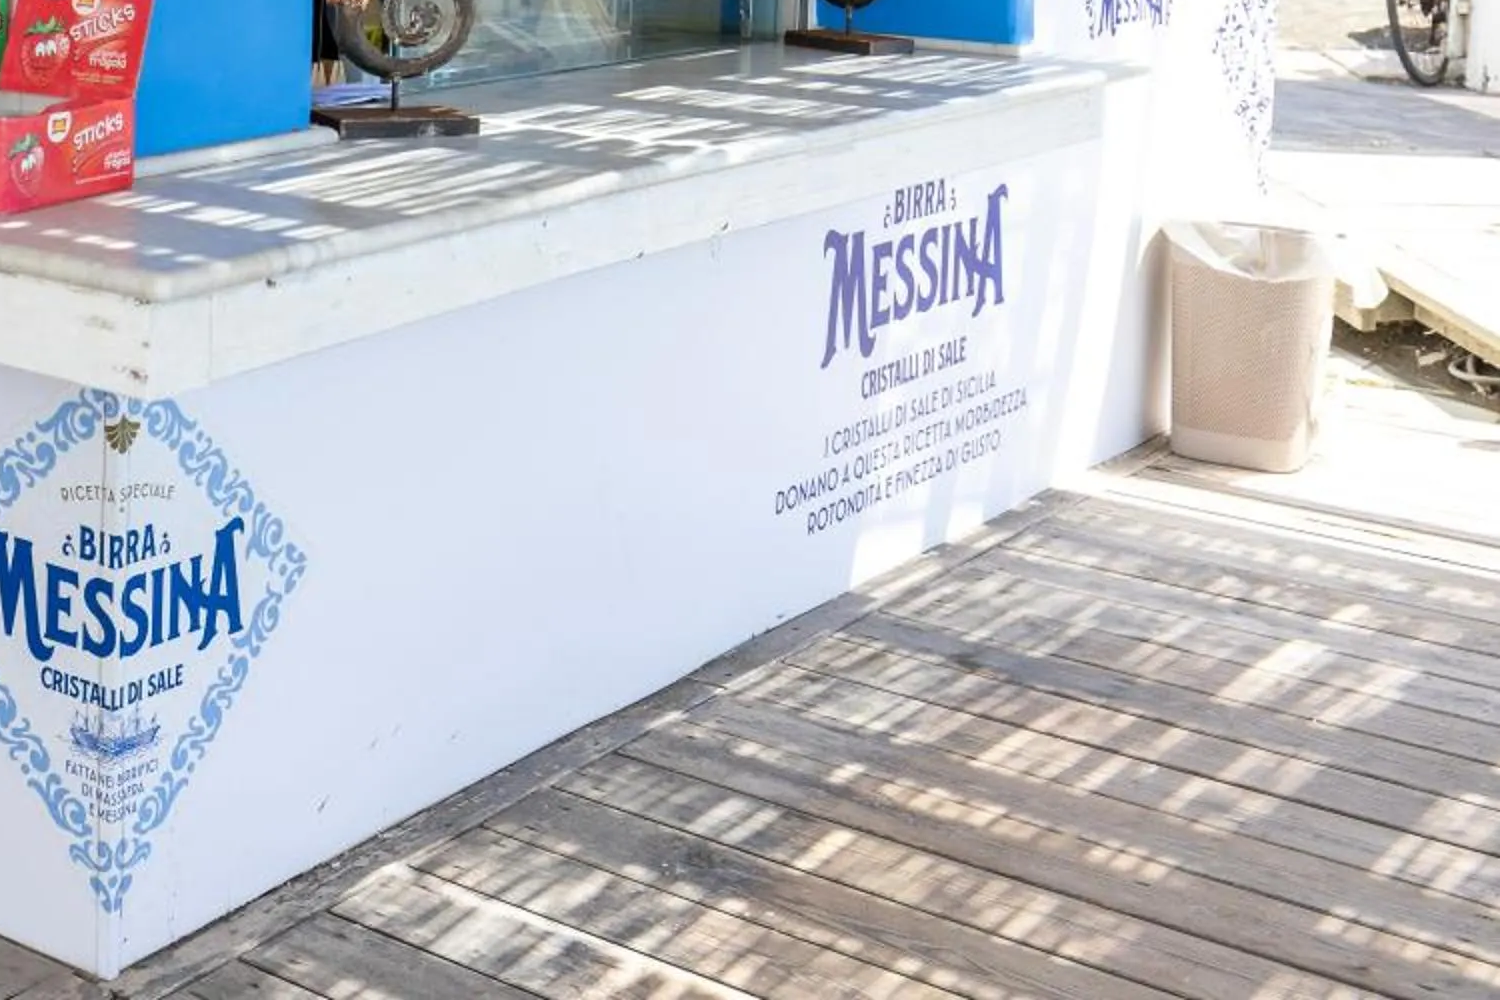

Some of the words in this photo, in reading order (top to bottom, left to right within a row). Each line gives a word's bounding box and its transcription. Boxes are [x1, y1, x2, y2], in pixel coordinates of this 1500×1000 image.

[70, 3, 136, 41] STICKS
[73, 112, 125, 150] STICKS
[893, 178, 947, 225] BIRRA
[820, 183, 1009, 370] MESSINA
[861, 353, 919, 400] CRISTALLI
[923, 347, 935, 376] DI
[937, 335, 968, 372] SALE
[831, 408, 893, 456] CRISTALLI
[895, 405, 907, 429] DI
[910, 390, 939, 422] SALE
[941, 386, 953, 410] DI
[956, 370, 996, 404] SICILIA
[60, 484, 115, 504] RICETTA
[119, 482, 177, 504] SPECIALE
[775, 467, 839, 515] DONANO
[842, 463, 850, 486] A
[853, 440, 901, 480] QUESTA
[903, 423, 951, 457] RICETTA
[807, 474, 882, 536] ROTONDITÀ
[885, 476, 893, 499] E
[895, 456, 943, 497] FINEZZA
[946, 447, 959, 472] DI
[79, 523, 156, 570] BIRRA
[41, 666, 124, 712] CRISTALLI
[128, 679, 143, 704] DI
[148, 663, 184, 697] SALE
[65, 759, 97, 783] FATTA
